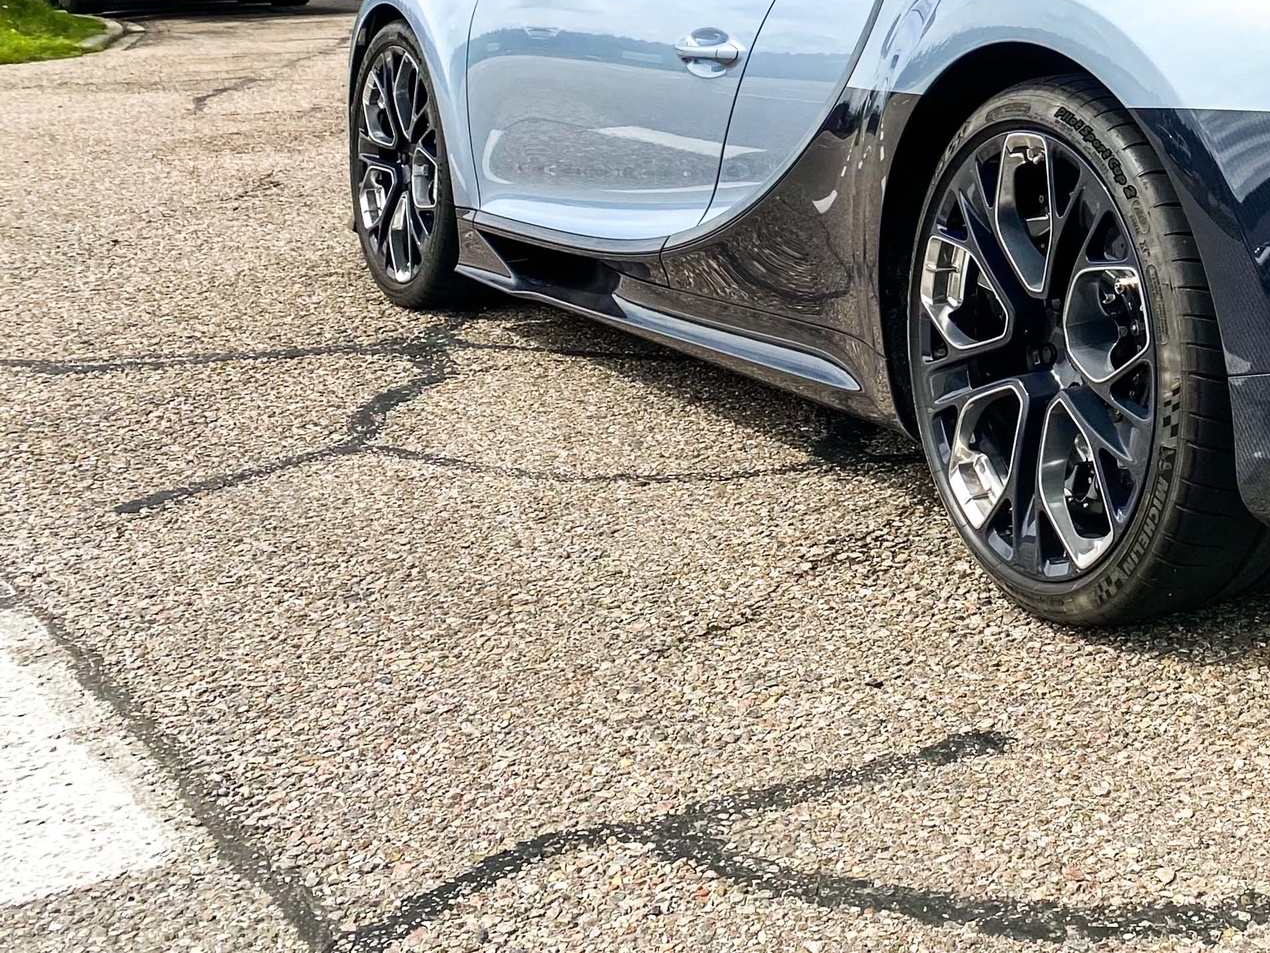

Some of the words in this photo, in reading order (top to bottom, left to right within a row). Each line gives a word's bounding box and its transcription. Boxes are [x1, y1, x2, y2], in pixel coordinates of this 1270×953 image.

[1054, 106, 1085, 132] Pilot
[1079, 125, 1113, 160] Sport
[1108, 157, 1128, 186] Cup
[1123, 184, 1138, 199] 2
[1122, 476, 1169, 576] MICHELIN
